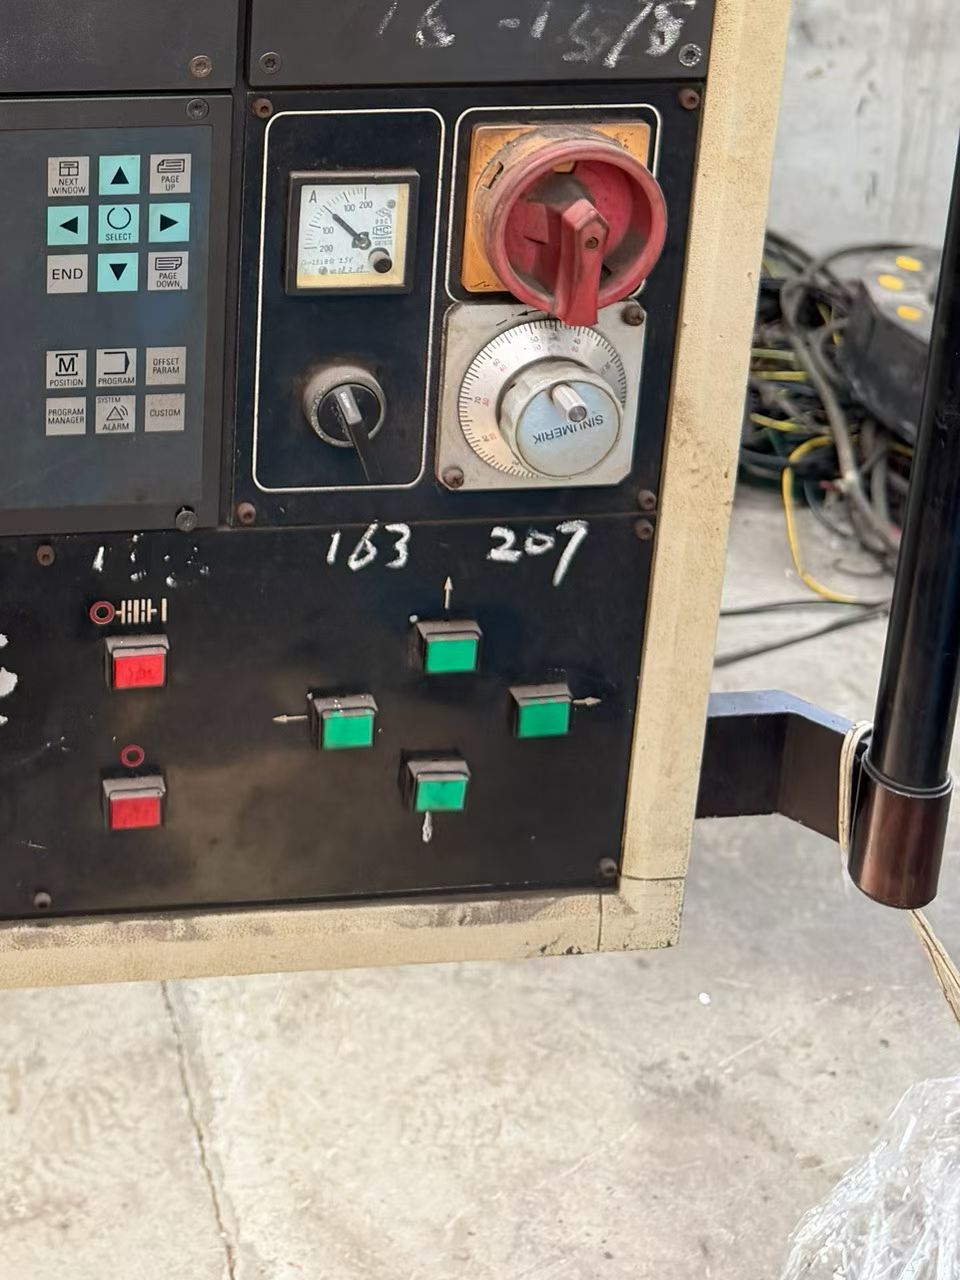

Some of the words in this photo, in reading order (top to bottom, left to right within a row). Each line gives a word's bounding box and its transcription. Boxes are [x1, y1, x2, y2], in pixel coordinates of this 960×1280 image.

[58, 178, 79, 186] NEXT
[161, 175, 180, 183] PAGE
[51, 186, 86, 195] WINDOW
[165, 183, 176, 191] UP
[309, 189, 317, 204] A
[343, 203, 356, 212] 100
[359, 201, 373, 209] 200
[322, 226, 334, 235] 100
[105, 232, 132, 241] SELECT
[320, 244, 334, 253] 200
[52, 268, 83, 280] END
[158, 272, 177, 280] PAGE
[156, 280, 180, 288] DOWN
[153, 357, 179, 366] OFFSET
[152, 366, 180, 374] PARAM
[49, 378, 84, 387] POSITION
[97, 377, 135, 385] PROGRAM
[48, 408, 84, 417] PROGRAM
[149, 409, 181, 417] CUSTOM
[48, 416, 85, 425] MANAGER
[102, 423, 130, 431] ALARM
[326, 519, 411, 572] 163
